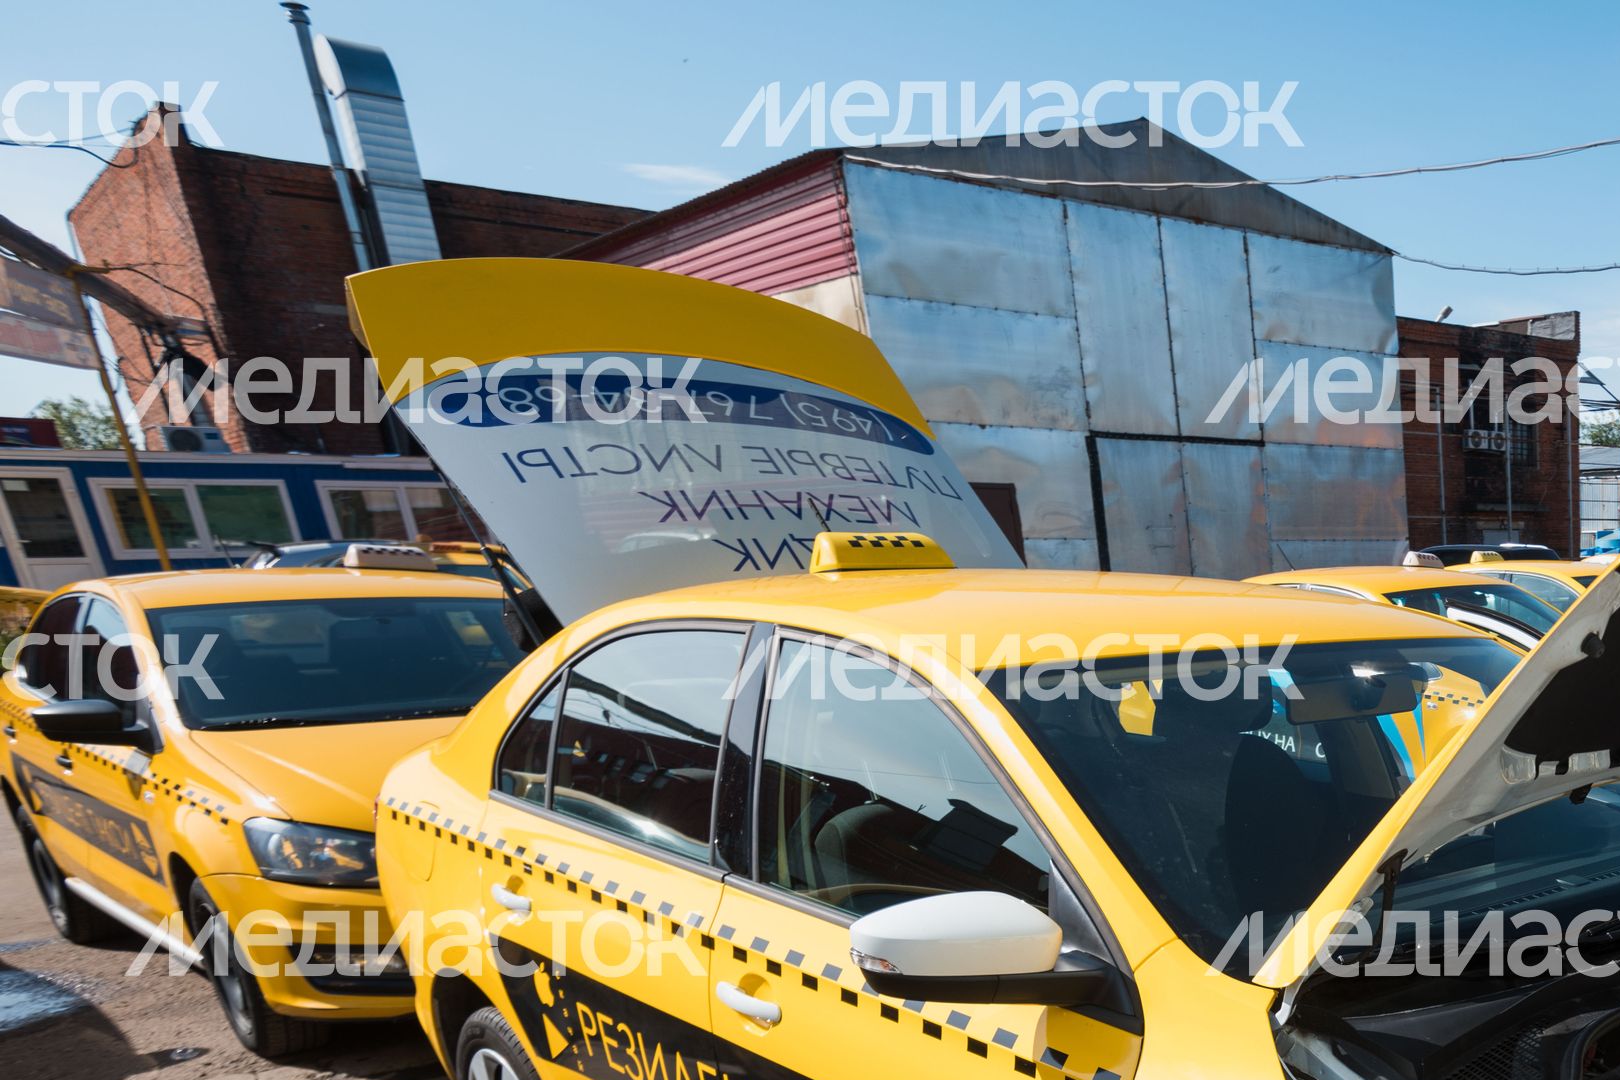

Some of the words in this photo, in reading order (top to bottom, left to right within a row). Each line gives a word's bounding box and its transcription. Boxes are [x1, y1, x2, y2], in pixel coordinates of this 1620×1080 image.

[779, 391, 894, 441] (495)
[502, 443, 722, 484] ЛИСТЫ
[755, 446, 962, 501] ПУТЕВЫЕ
[639, 489, 920, 527] МЕХАНИК
